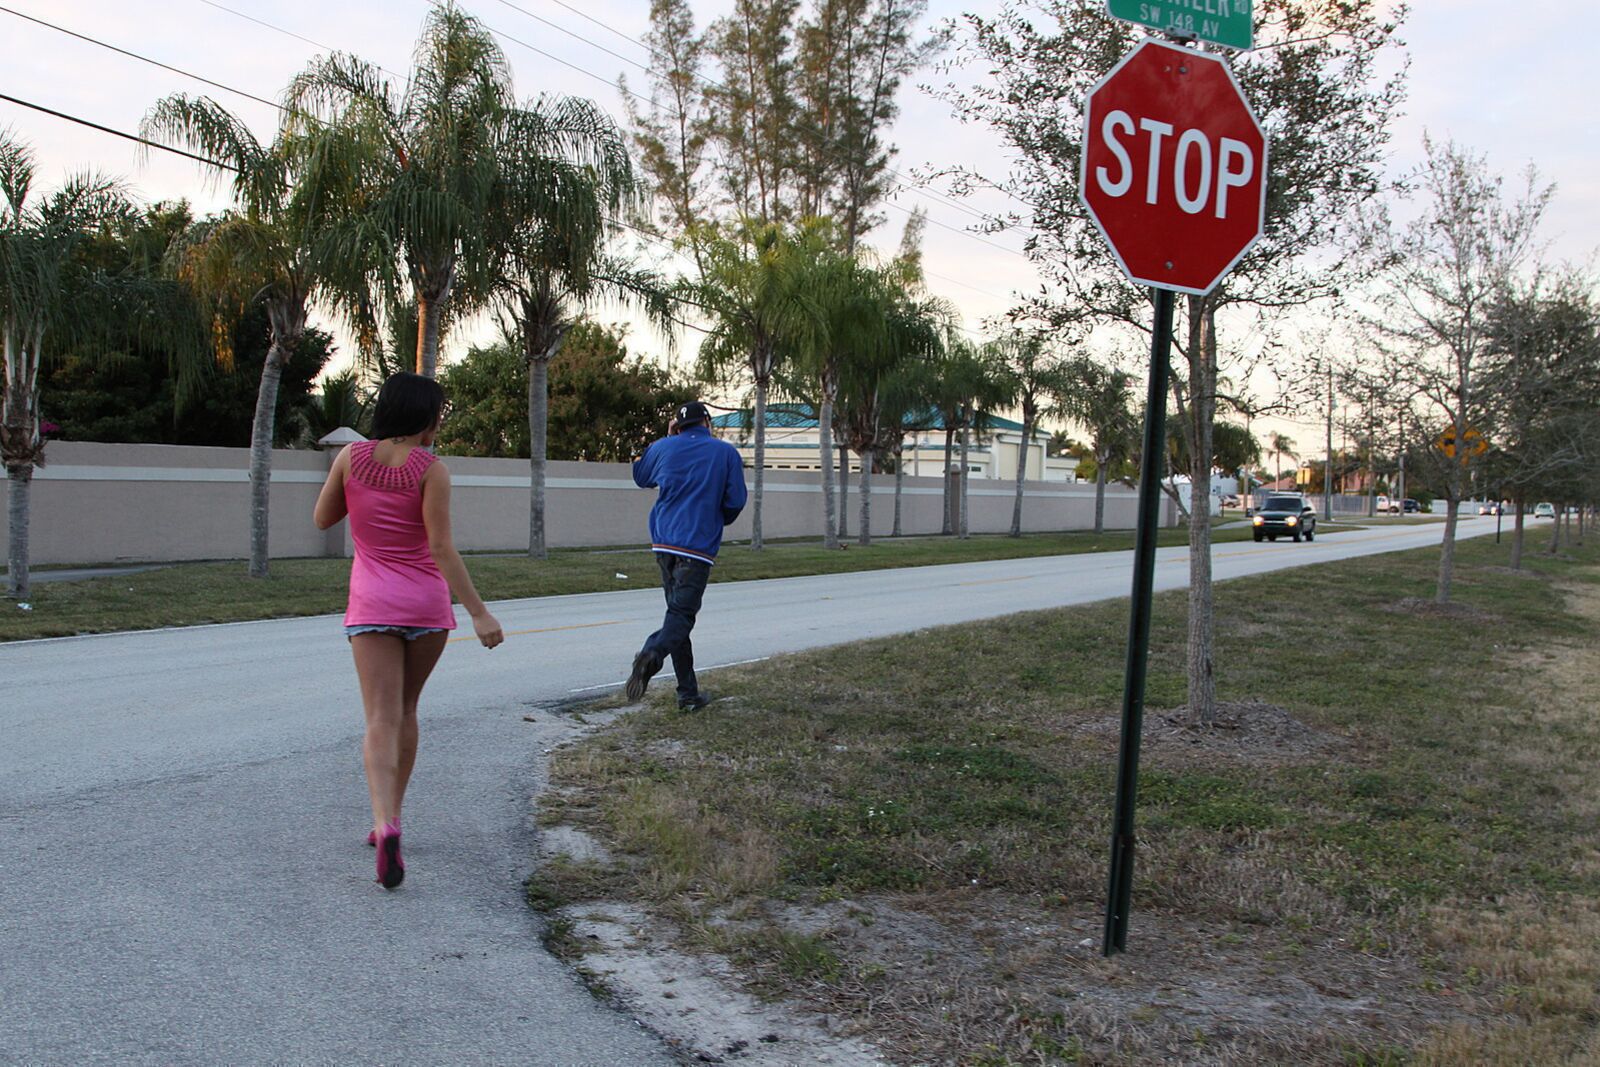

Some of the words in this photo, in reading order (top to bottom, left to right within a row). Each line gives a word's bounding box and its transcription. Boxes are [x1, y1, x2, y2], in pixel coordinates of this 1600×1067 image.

[1140, 3, 1161, 24] SW
[1170, 10, 1194, 32] 148
[1202, 19, 1219, 38] AV
[1095, 109, 1254, 218] STOP
